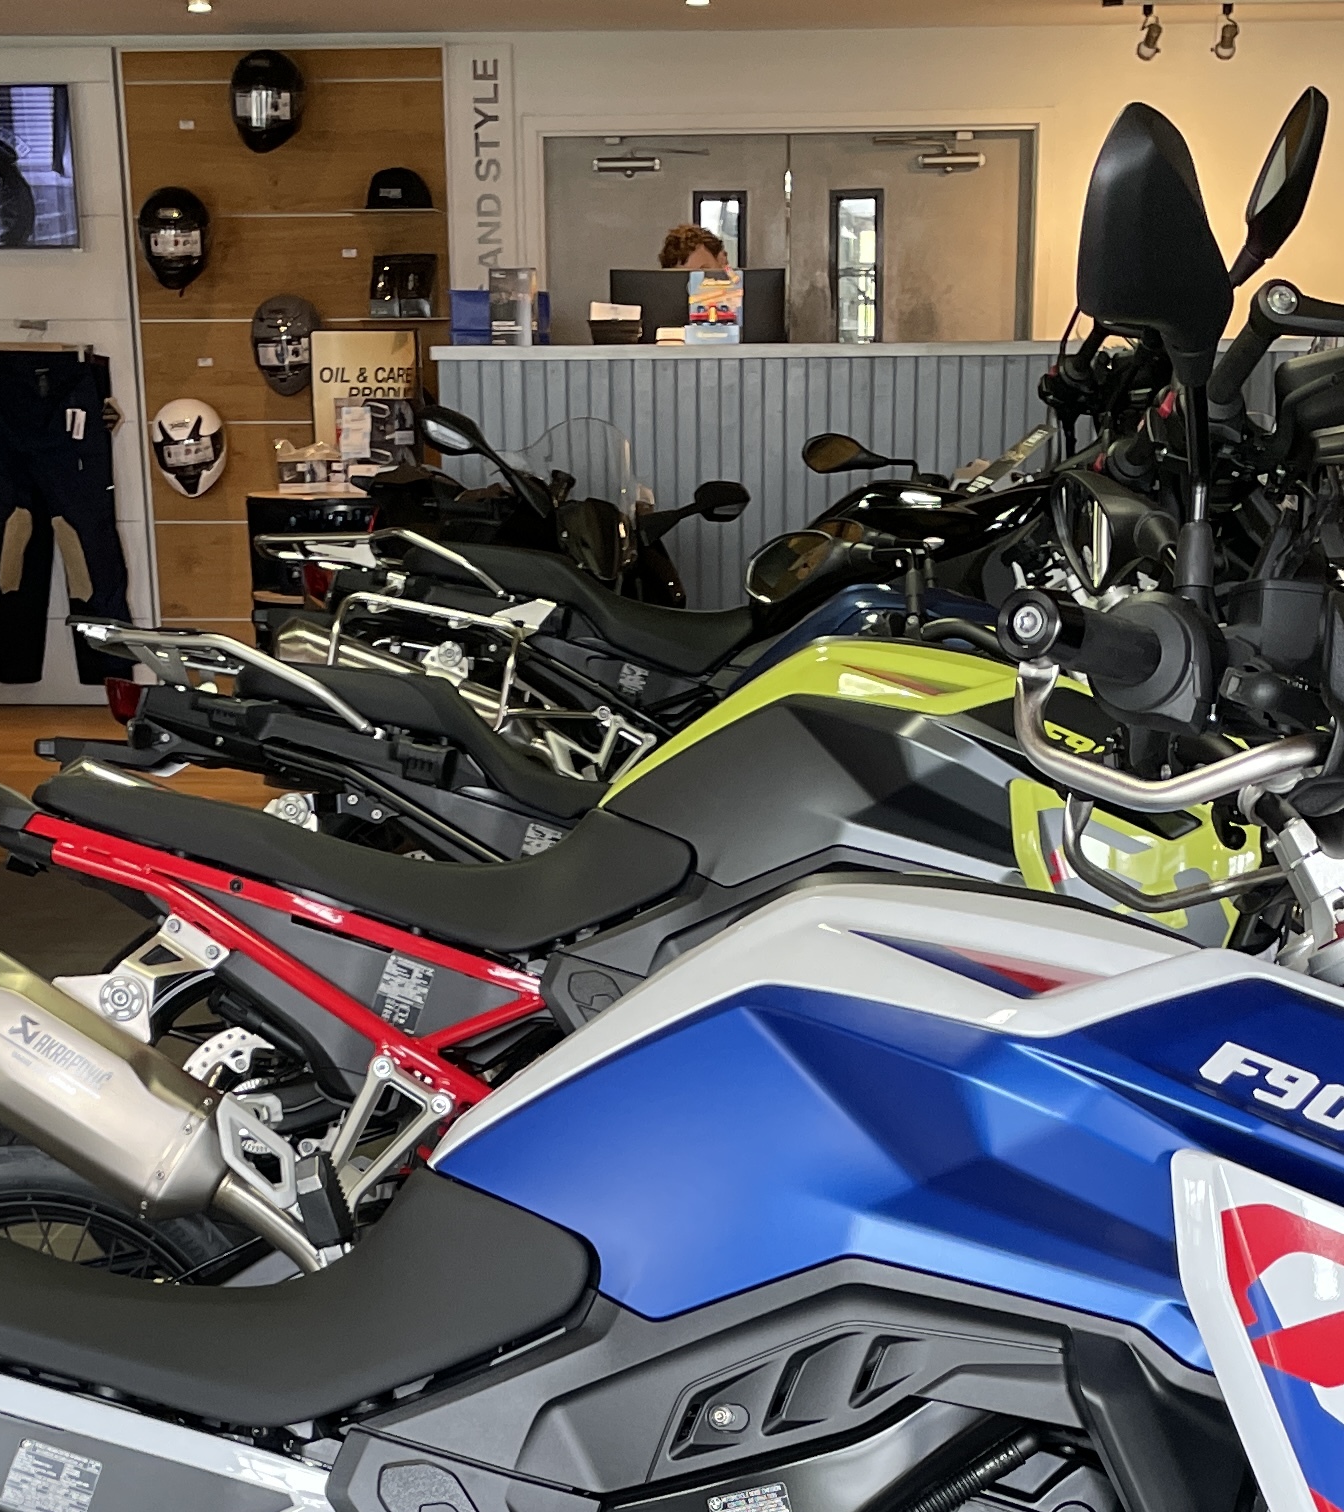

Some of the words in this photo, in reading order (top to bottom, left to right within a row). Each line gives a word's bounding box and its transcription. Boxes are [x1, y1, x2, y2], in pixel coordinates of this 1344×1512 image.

[472, 58, 502, 182] STYLE
[478, 193, 504, 270] AND
[319, 366, 350, 383] OIL
[356, 367, 368, 382] &
[374, 366, 413, 383] CARE
